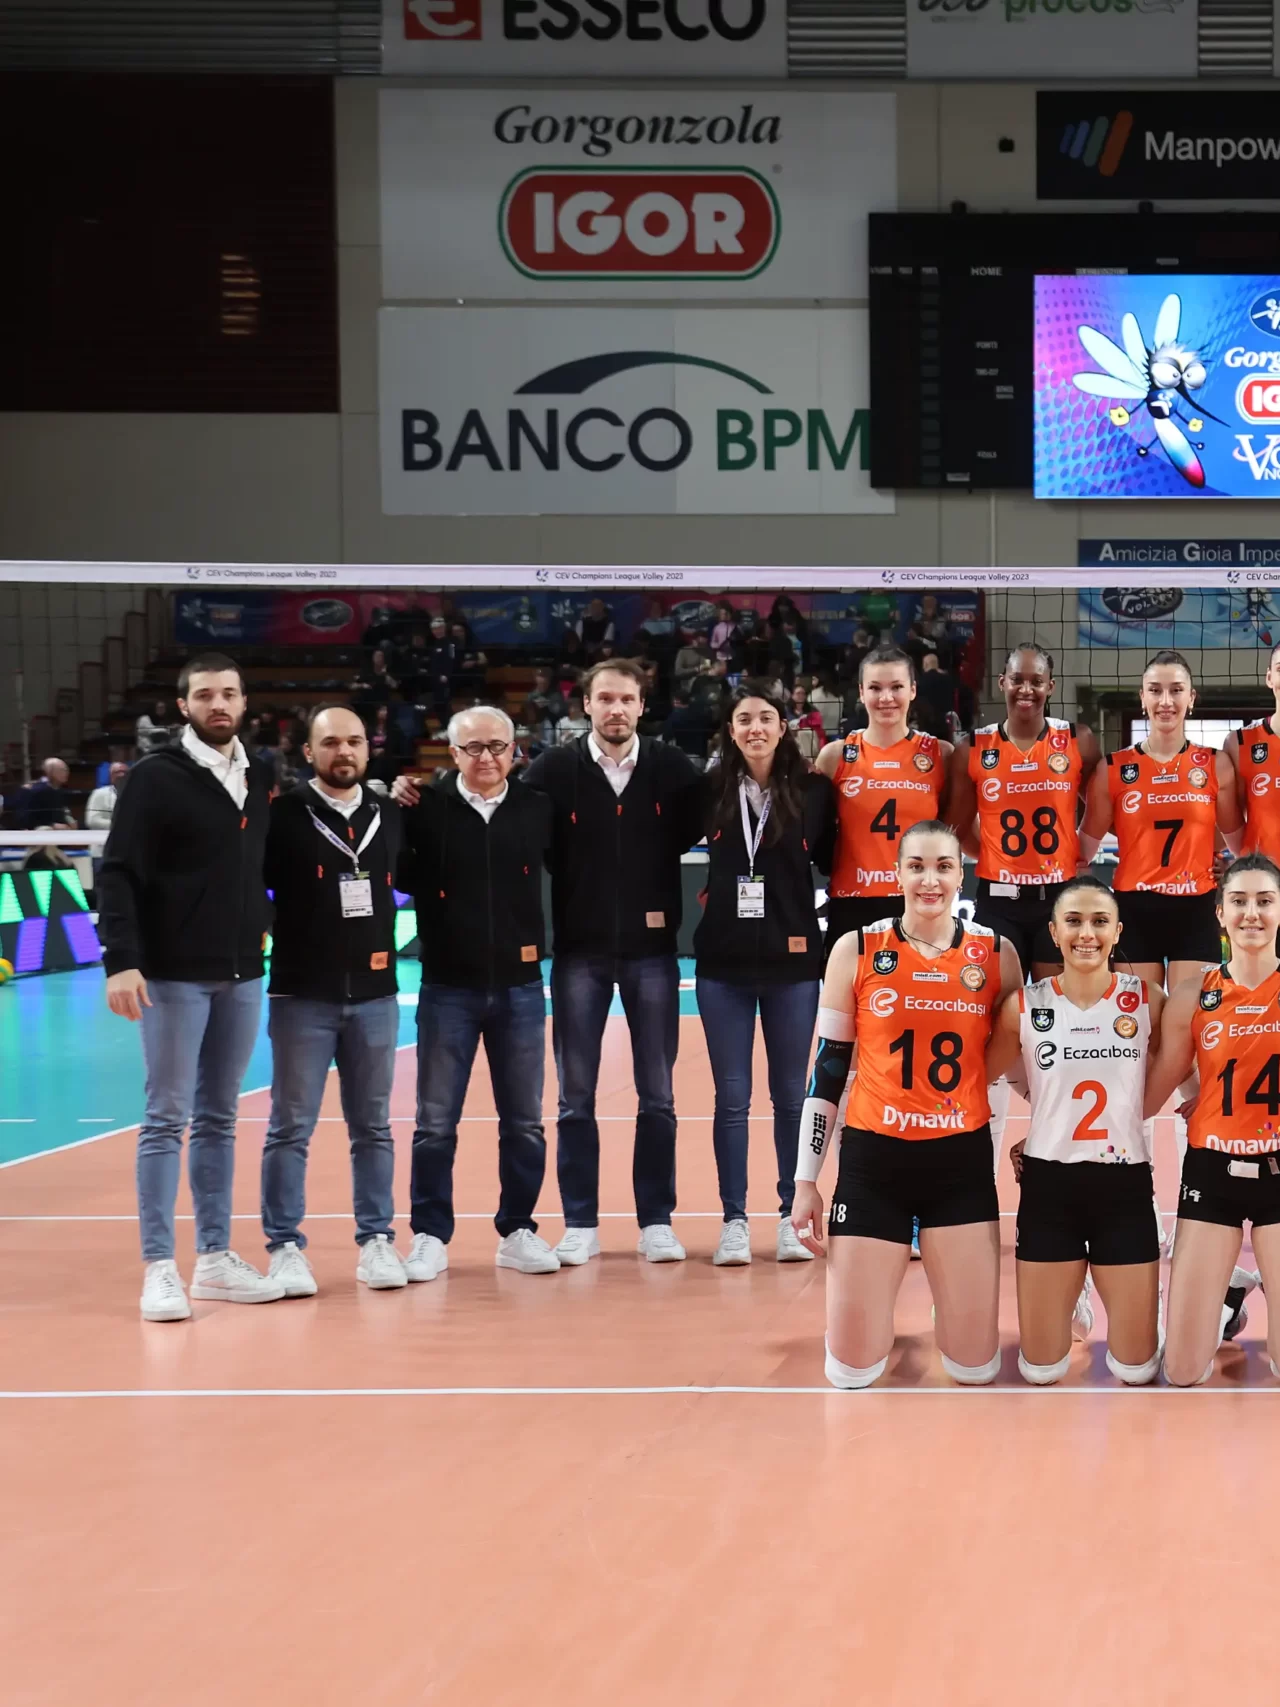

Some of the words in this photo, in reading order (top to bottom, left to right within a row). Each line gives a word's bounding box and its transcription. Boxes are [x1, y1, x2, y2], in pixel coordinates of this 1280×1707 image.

[504, 0, 766, 41] ESSECO
[493, 104, 782, 157] Gorgonzola
[533, 190, 745, 256] IGOR
[970, 266, 1003, 276] HOME
[402, 406, 693, 473] BANCO
[716, 408, 871, 472] BPM
[1099, 542, 1177, 562] Amicizia
[1183, 542, 1232, 562] Gioia
[555, 572, 571, 580] CEV
[572, 572, 612, 582] Champions
[614, 572, 640, 582] League
[642, 572, 665, 582] Volley
[667, 572, 684, 580] 2023
[900, 573, 916, 581] CEV
[918, 573, 957, 583] Champions
[960, 573, 985, 583] League
[987, 573, 1010, 583] Volley
[1012, 573, 1029, 581] 2023
[1246, 572, 1261, 580] CEV
[866, 778, 931, 794] Eczacıbaşı
[1006, 779, 1071, 794] Eczacıbaşı
[1147, 791, 1211, 806] Eczacıbaşı
[870, 799, 900, 841] 4
[1000, 806, 1059, 857] 88
[1154, 819, 1184, 867] 7
[999, 869, 1064, 885] Dynavit
[904, 994, 986, 1017] Eczacıbaşı
[889, 1028, 964, 1093] 18
[1063, 1045, 1141, 1063] Eczacıbaşı
[882, 1104, 966, 1132] Dynavit
[1071, 1079, 1108, 1141] 2
[832, 1203, 848, 1224] 18
